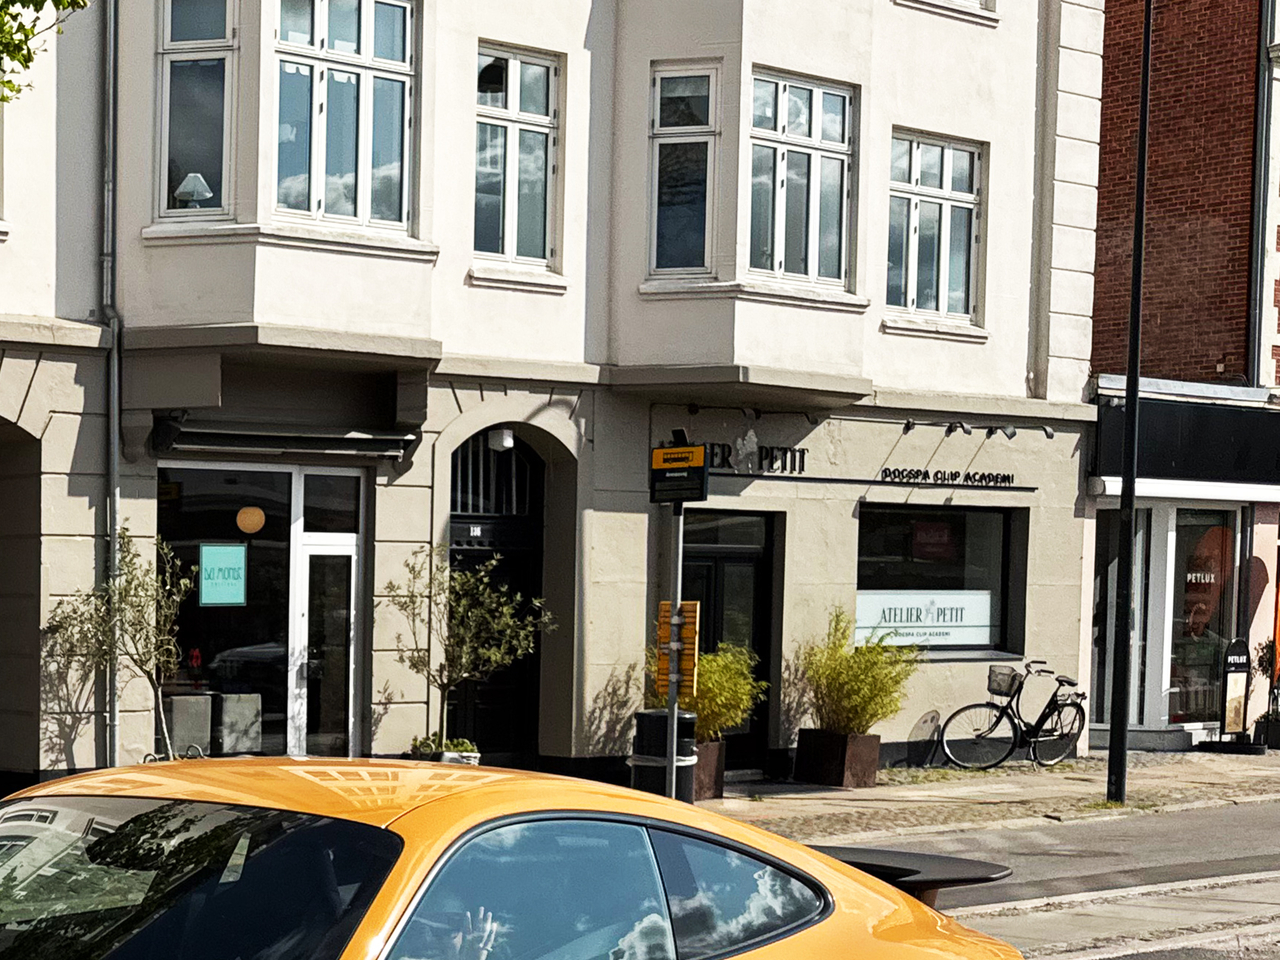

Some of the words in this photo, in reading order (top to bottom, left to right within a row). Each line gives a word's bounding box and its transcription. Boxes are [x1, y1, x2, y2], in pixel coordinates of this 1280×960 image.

[758, 445, 809, 474] PETIT
[1187, 573, 1215, 583] PETLUX
[880, 606, 923, 624] ATELIER
[936, 606, 966, 624] PETIT
[1227, 655, 1247, 664] PETLUX
